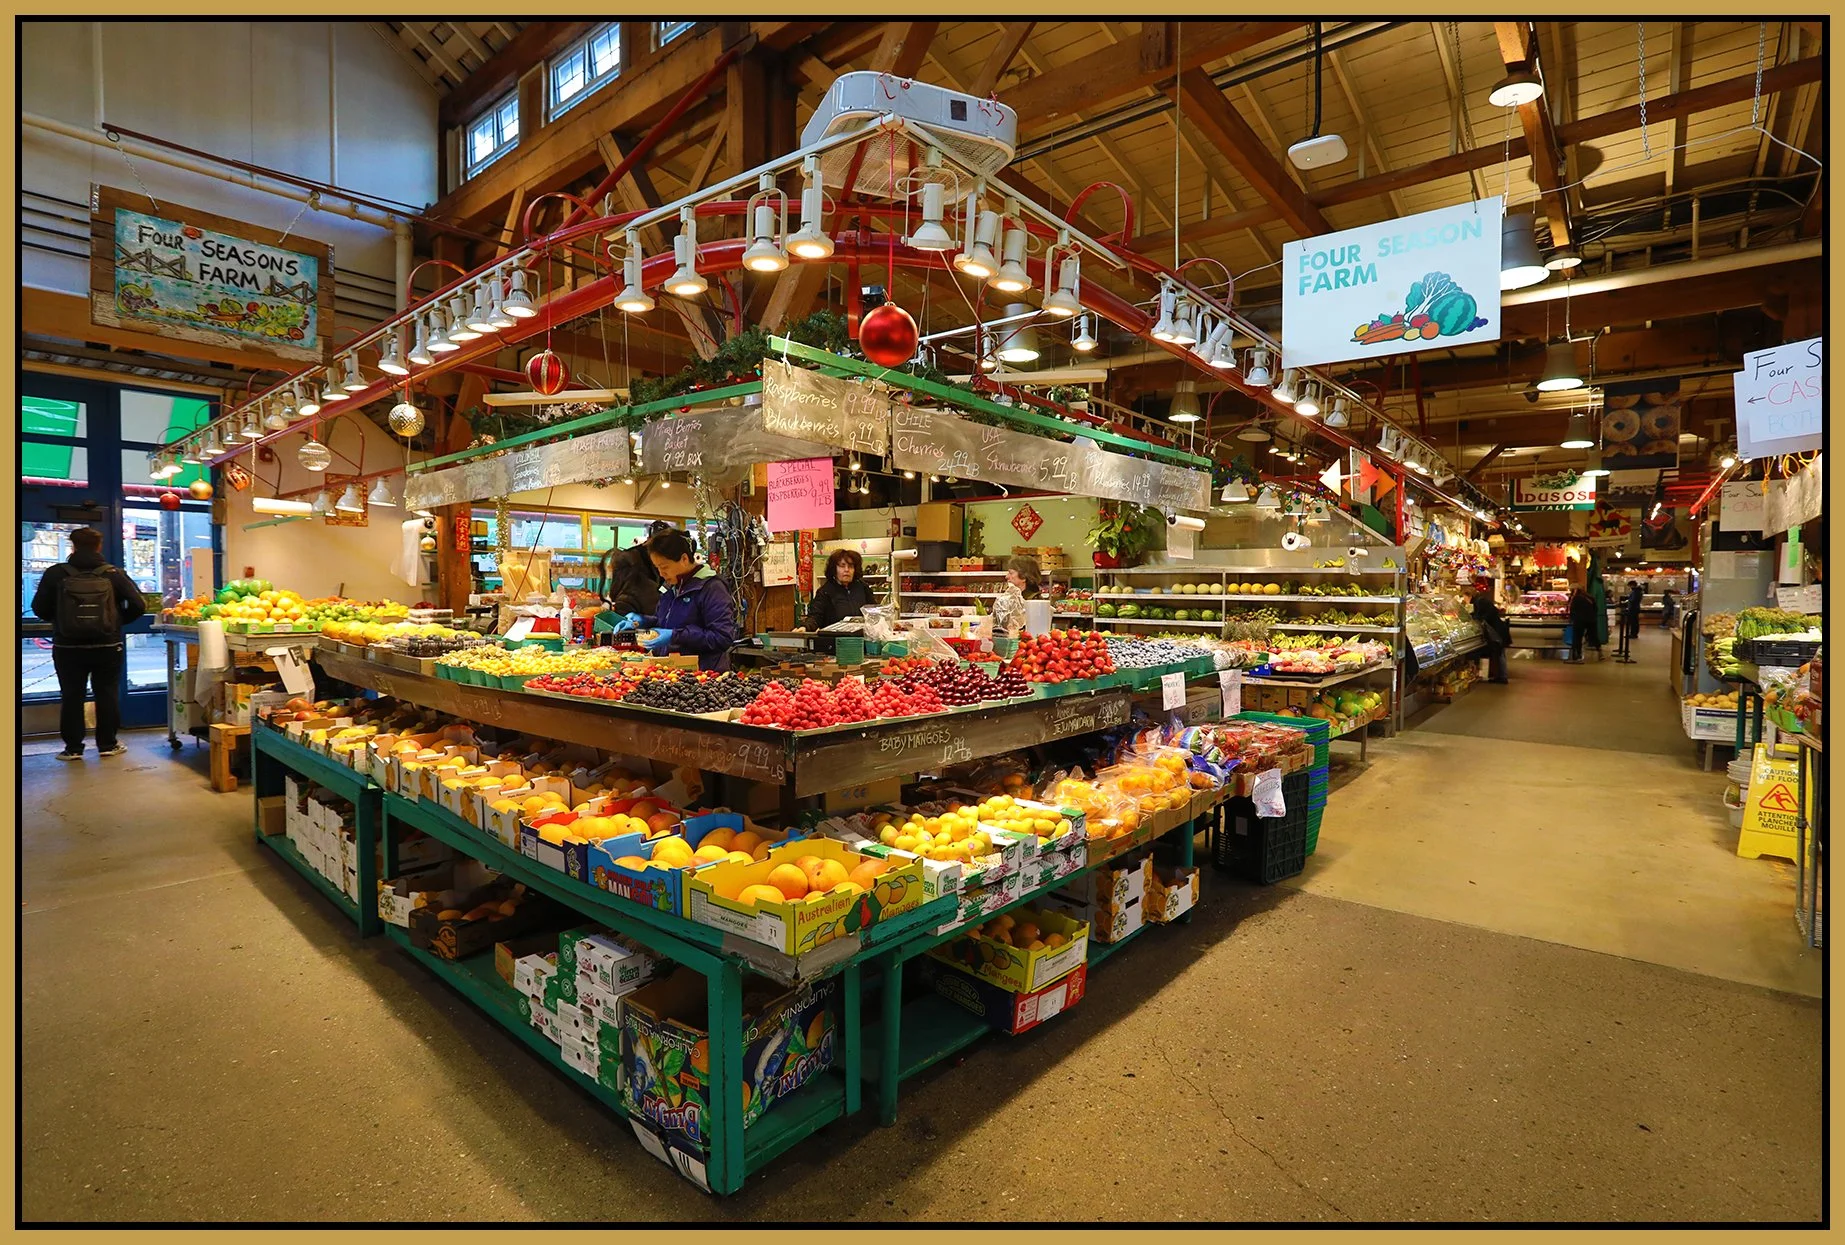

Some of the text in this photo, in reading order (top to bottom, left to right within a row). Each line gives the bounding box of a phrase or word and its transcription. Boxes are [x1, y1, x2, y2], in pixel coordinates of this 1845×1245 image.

[200, 240, 298, 276] SEASONS
[1299, 217, 1482, 274] FOUR SEASON
[199, 263, 260, 290] FARM
[1298, 263, 1378, 296] FARM
[1753, 341, 1822, 381] Four S
[765, 377, 838, 410] Raspberries
[1767, 376, 1821, 405] CAS
[895, 411, 933, 429] CHILE
[981, 427, 1001, 444] USA
[779, 459, 817, 474] SPECIAL
[1063, 470, 1078, 490] LB
[1535, 504, 1574, 512] ITALIA
[770, 764, 785, 780] LB
[1778, 775, 1800, 784] FLOO
[1758, 817, 1799, 827] PLANCHE
[797, 896, 851, 926] Australian
[649, 1030, 701, 1057] CALIFORNIA
